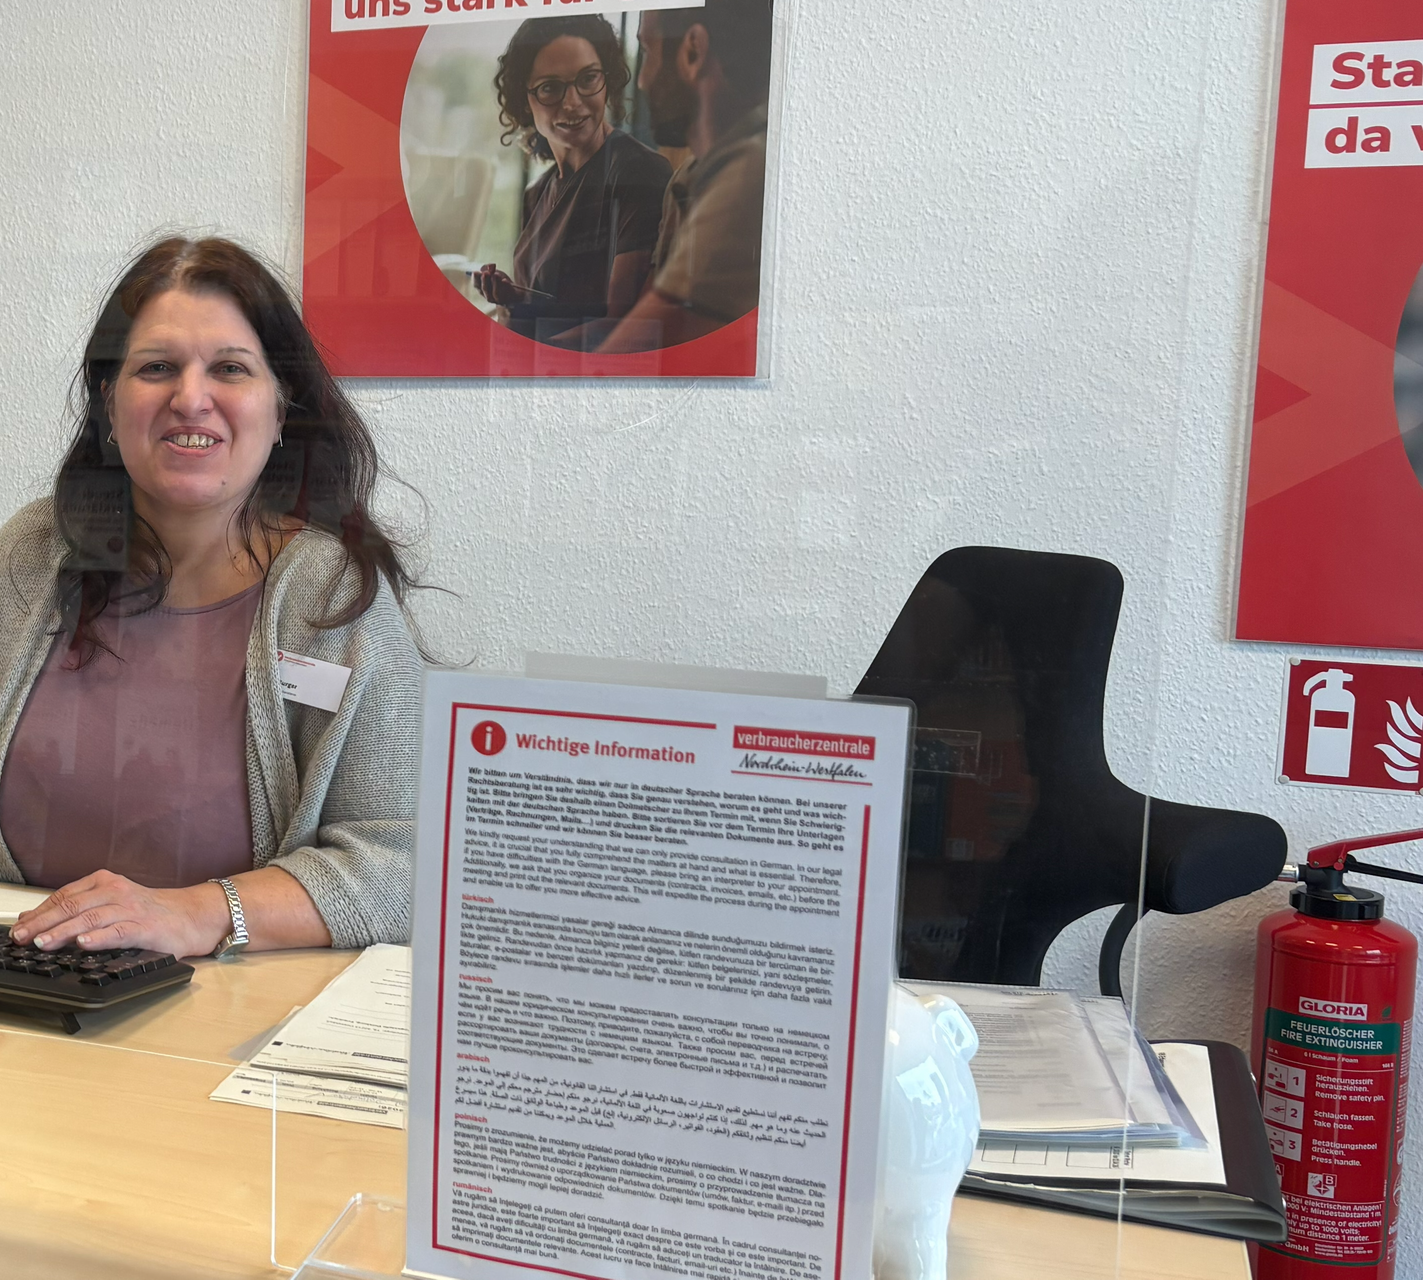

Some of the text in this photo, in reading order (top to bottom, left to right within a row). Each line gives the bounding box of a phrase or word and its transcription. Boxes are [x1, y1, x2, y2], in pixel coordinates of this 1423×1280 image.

[1330, 51, 1423, 90] Sta
[1324, 116, 1392, 154] da
[516, 733, 695, 763] Wichtige Information
[736, 730, 871, 757] verbraucherzentrale
[640, 784, 847, 810] deutscher Sprache beraten können. Bei unserer
[673, 798, 717, 808] verstehen,
[719, 802, 748, 810] worum
[762, 806, 782, 814] geht
[783, 808, 801, 816] und
[802, 810, 820, 818] was
[709, 809, 738, 820] Termin
[758, 816, 781, 824] wenn
[783, 817, 797, 826] Sie
[653, 816, 691, 825] sortieren
[692, 818, 706, 827] Sie
[724, 822, 743, 830] dem
[746, 823, 775, 834] Termin
[777, 827, 794, 836] Ihre
[796, 829, 844, 841] Unterlagen
[664, 826, 677, 834] die
[679, 828, 723, 838] relevanten
[725, 831, 774, 844] Dokumente
[776, 838, 794, 846] aus.
[797, 839, 809, 847] So
[811, 841, 831, 850] geht
[1300, 1000, 1365, 1017] GLORIA
[1290, 1020, 1375, 1039] FEUERLÖSCHER
[1280, 1029, 1383, 1050] FIRE EXTINGUISHER
[1312, 1053, 1336, 1061] Schaum
[1292, 1076, 1299, 1086] 1
[1315, 1074, 1373, 1085] Sicherungsstift
[1315, 1081, 1369, 1092] herausziehen.
[1315, 1091, 1385, 1102] Remove safety pin.
[454, 1112, 487, 1123] polnisch
[1290, 1108, 1297, 1118] 2
[1314, 1110, 1375, 1121] Schlauch fassen.
[1313, 1119, 1354, 1130] Take hose.
[1288, 1140, 1296, 1150] 3
[1312, 1139, 1377, 1150] Betätigungshebel
[1311, 1145, 1346, 1156] drücken.
[1311, 1155, 1362, 1166] Press handle.
[1325, 1175, 1334, 1185] B
[1290, 1195, 1382, 1211] bei elektrischen Anlagen!
[1286, 1202, 1300, 1210] 000
[1310, 1207, 1370, 1218] Mindestabstand
[1286, 1219, 1298, 1228] nly
[1299, 1222, 1309, 1231] up
[1300, 1214, 1336, 1226] presence
[1306, 1231, 1340, 1241] distance
[1284, 1242, 1310, 1252] GmbH
